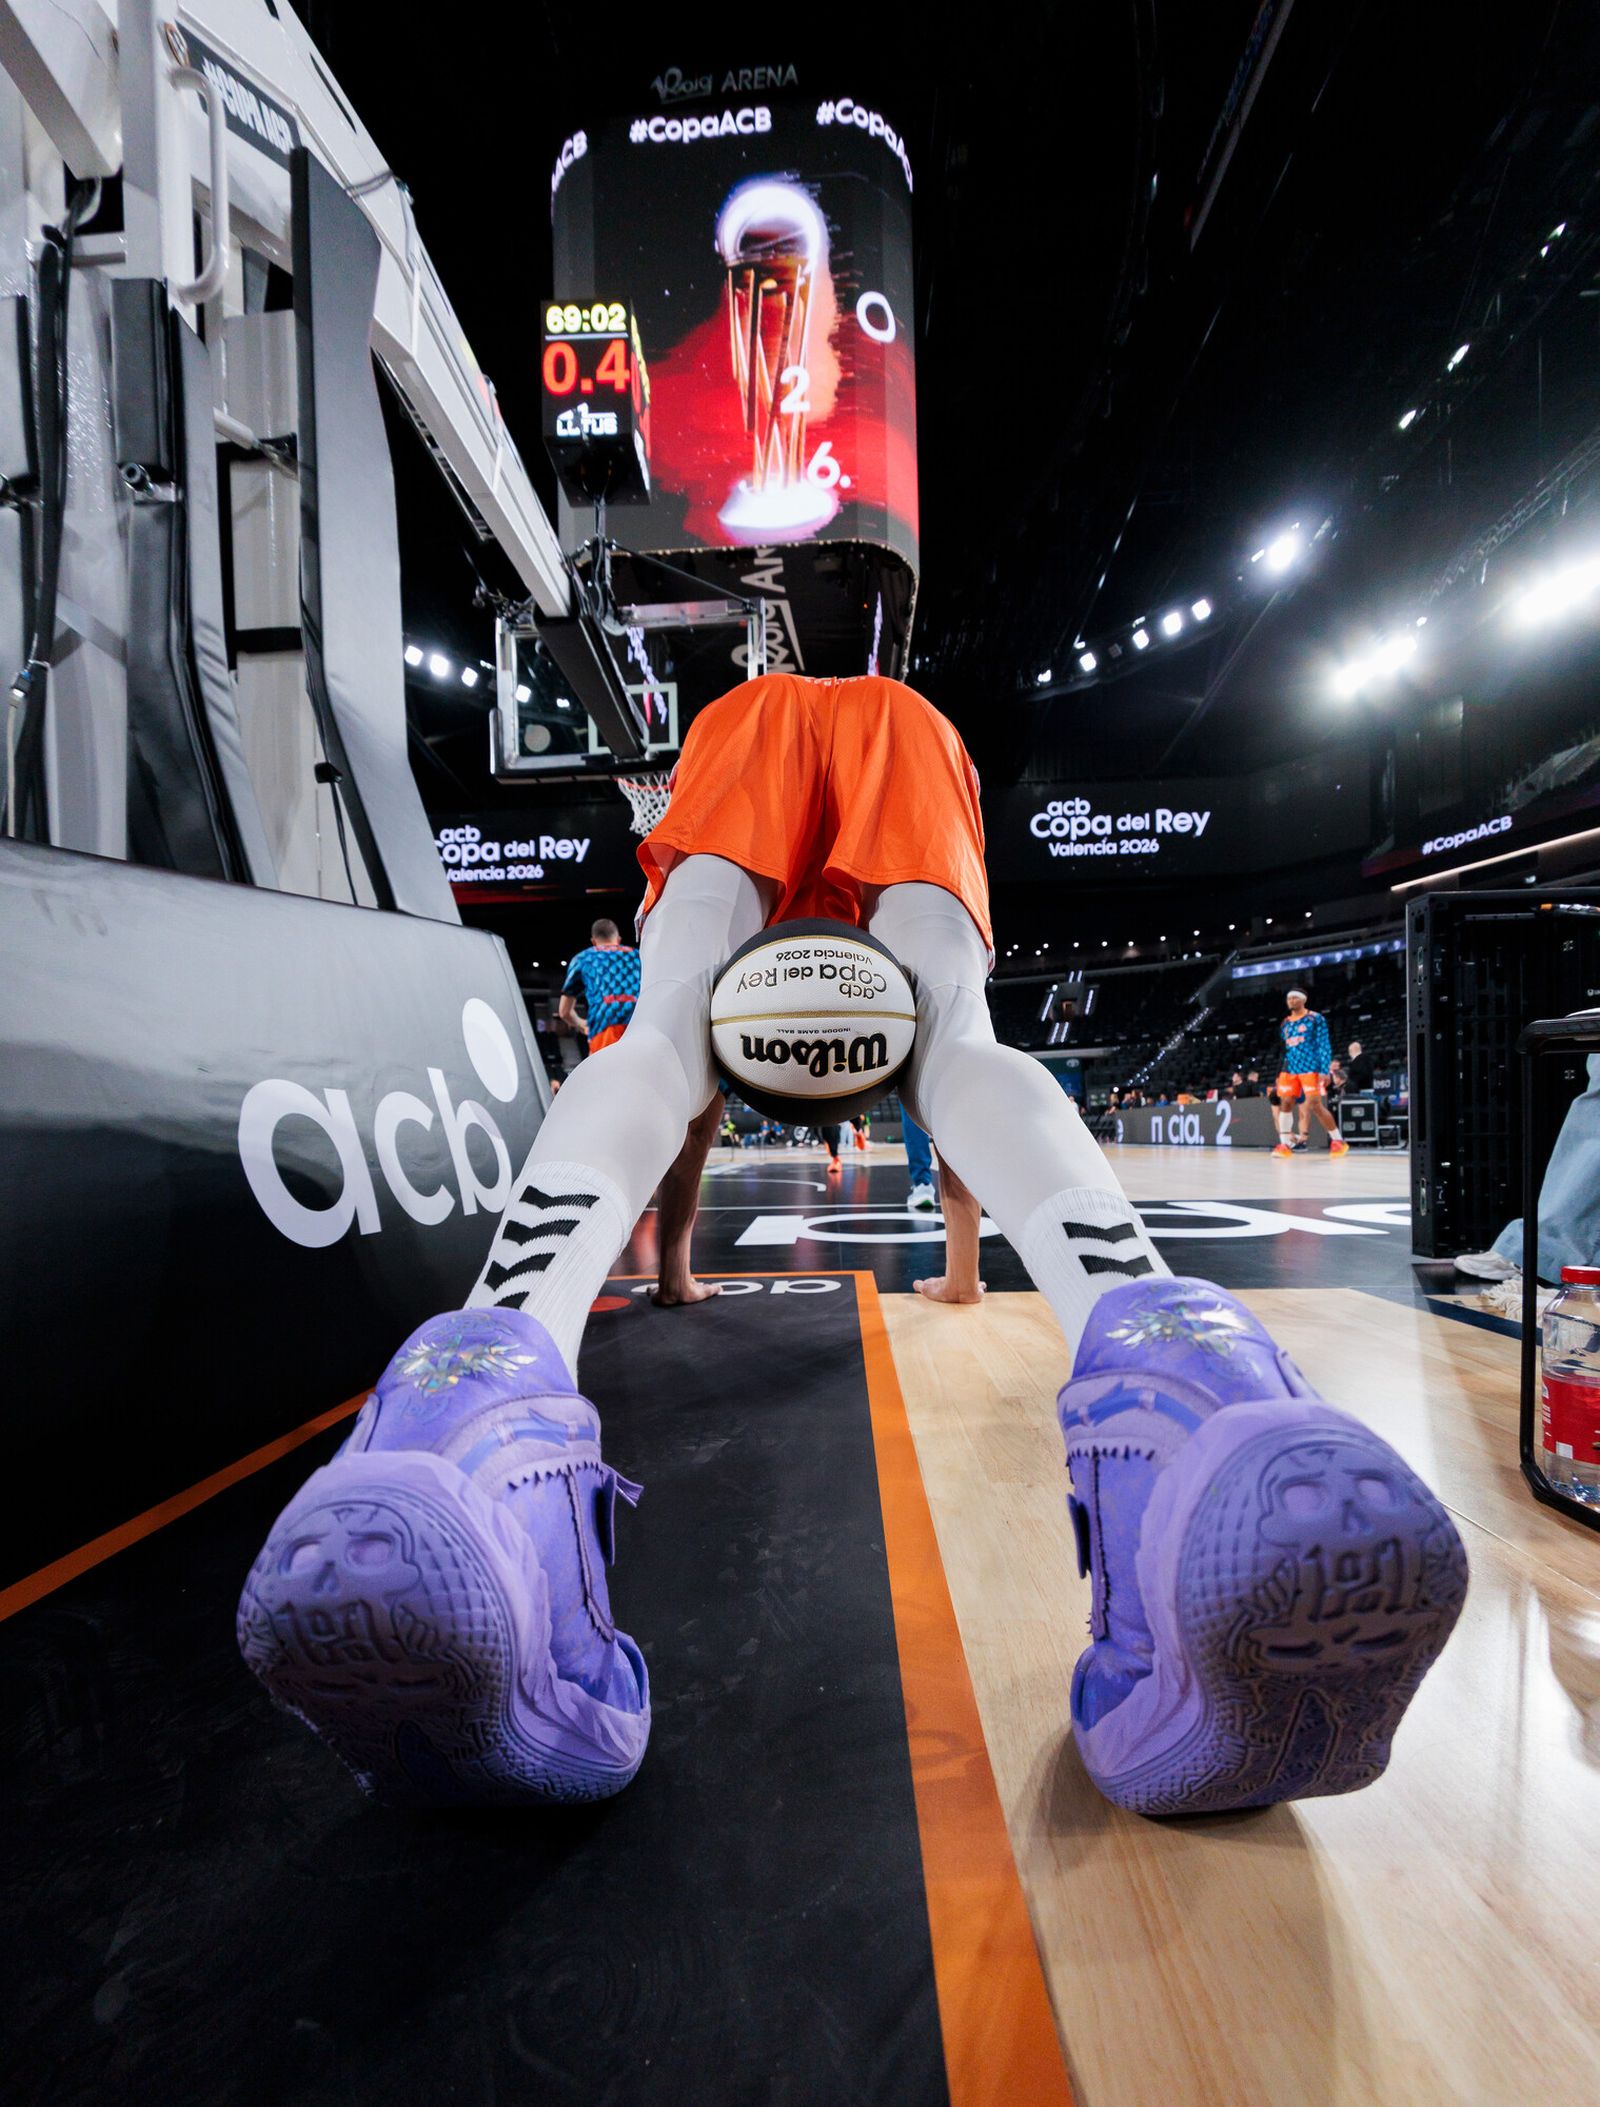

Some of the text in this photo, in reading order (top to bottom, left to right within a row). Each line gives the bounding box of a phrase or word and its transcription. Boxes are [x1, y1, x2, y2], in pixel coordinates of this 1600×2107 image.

[721, 64, 798, 93] ARENA
[629, 106, 772, 144] #CopaACB
[551, 130, 588, 192] ACB
[545, 302, 628, 334] 69:02
[542, 338, 632, 395] 0.4
[779, 366, 811, 414] 2
[806, 441, 851, 489] 6.
[1047, 797, 1092, 817] acb
[440, 825, 481, 845] acb
[1030, 808, 1211, 842] Copa del Rey
[1422, 815, 1513, 856] #CopaACB
[504, 840, 535, 859] del
[539, 835, 591, 864] Rey
[1049, 838, 1160, 857] Valencia 2026
[506, 864, 545, 881] 2026
[776, 949, 873, 966] Valencia 2026
[736, 963, 887, 994] Copa del Rey
[839, 981, 875, 1000] acb
[739, 1032, 889, 1078] Wilson
[1215, 1100, 1233, 1145] 2
[237, 1067, 513, 1248] acb
